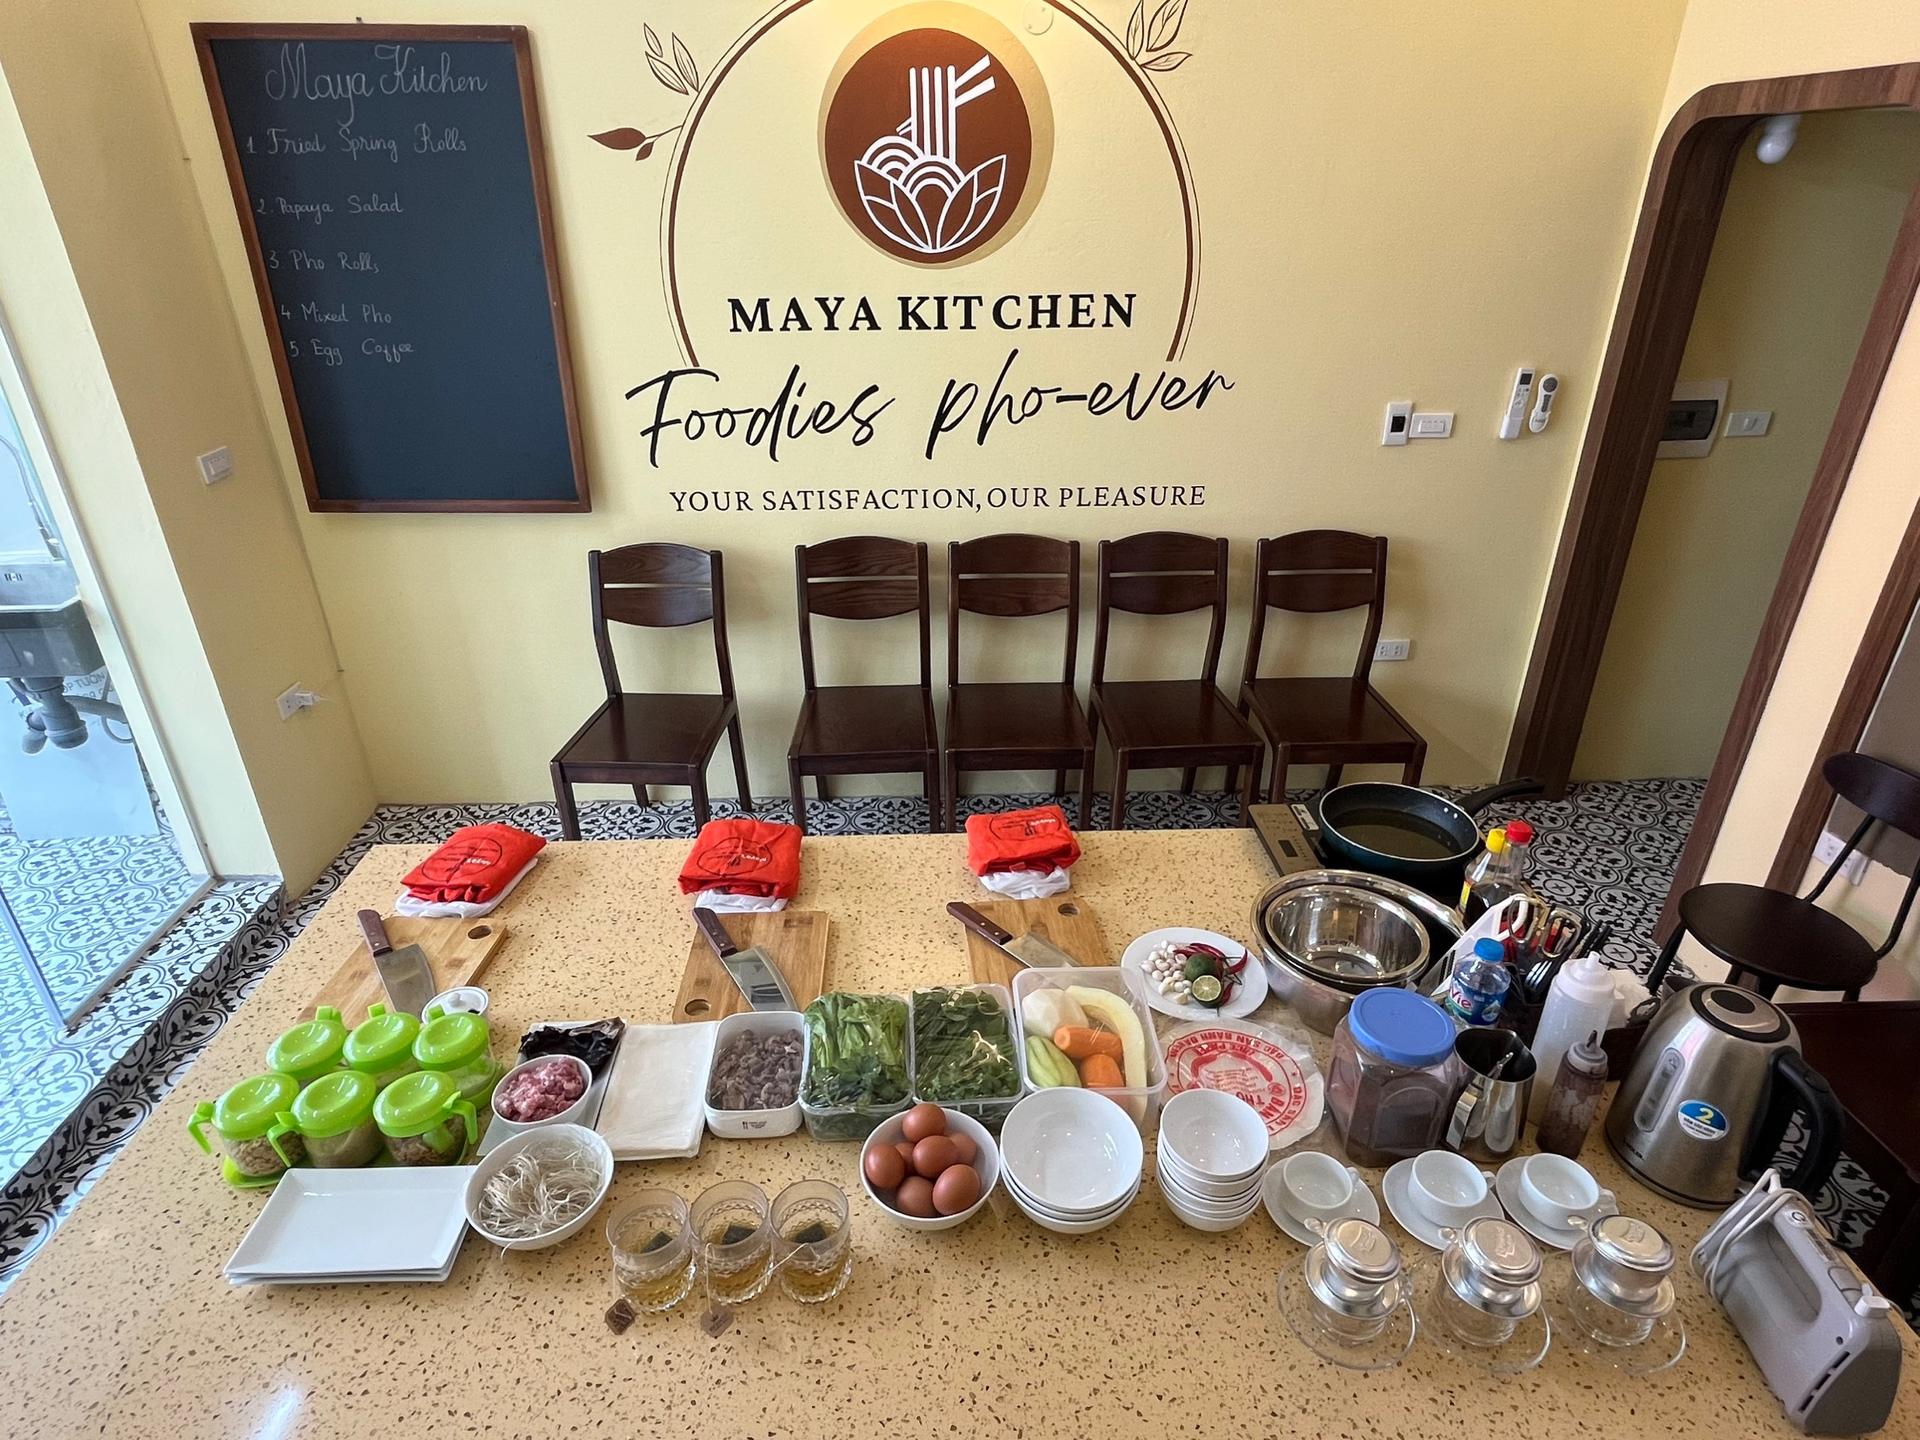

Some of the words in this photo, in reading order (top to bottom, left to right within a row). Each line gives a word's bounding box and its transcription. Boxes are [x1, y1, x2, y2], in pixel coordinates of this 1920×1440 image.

[265, 42, 374, 127] Maya
[375, 44, 488, 94] Kitchen
[267, 128, 326, 154] Fried
[339, 125, 398, 163] Spring
[414, 122, 467, 154] Rolls
[277, 197, 334, 225] Papaya
[347, 192, 404, 214] Salad
[289, 250, 325, 271] Pho
[337, 251, 380, 274] Rolls
[280, 304, 291, 320] 4
[301, 301, 349, 324] Mixed
[362, 304, 392, 324] Pho
[728, 295, 882, 333] MAYA
[899, 292, 1137, 331] KITCHEN
[311, 339, 344, 366] Egg
[361, 337, 415, 363] Coffee
[625, 364, 896, 468] Foodies
[924, 348, 1235, 460] pho-ever
[670, 490, 752, 513] YOUR
[762, 487, 983, 513] SATISFACTION,
[987, 487, 1048, 509] OUR
[1059, 484, 1206, 508] PLEASURE
[1696, 1107, 1714, 1124] 2
